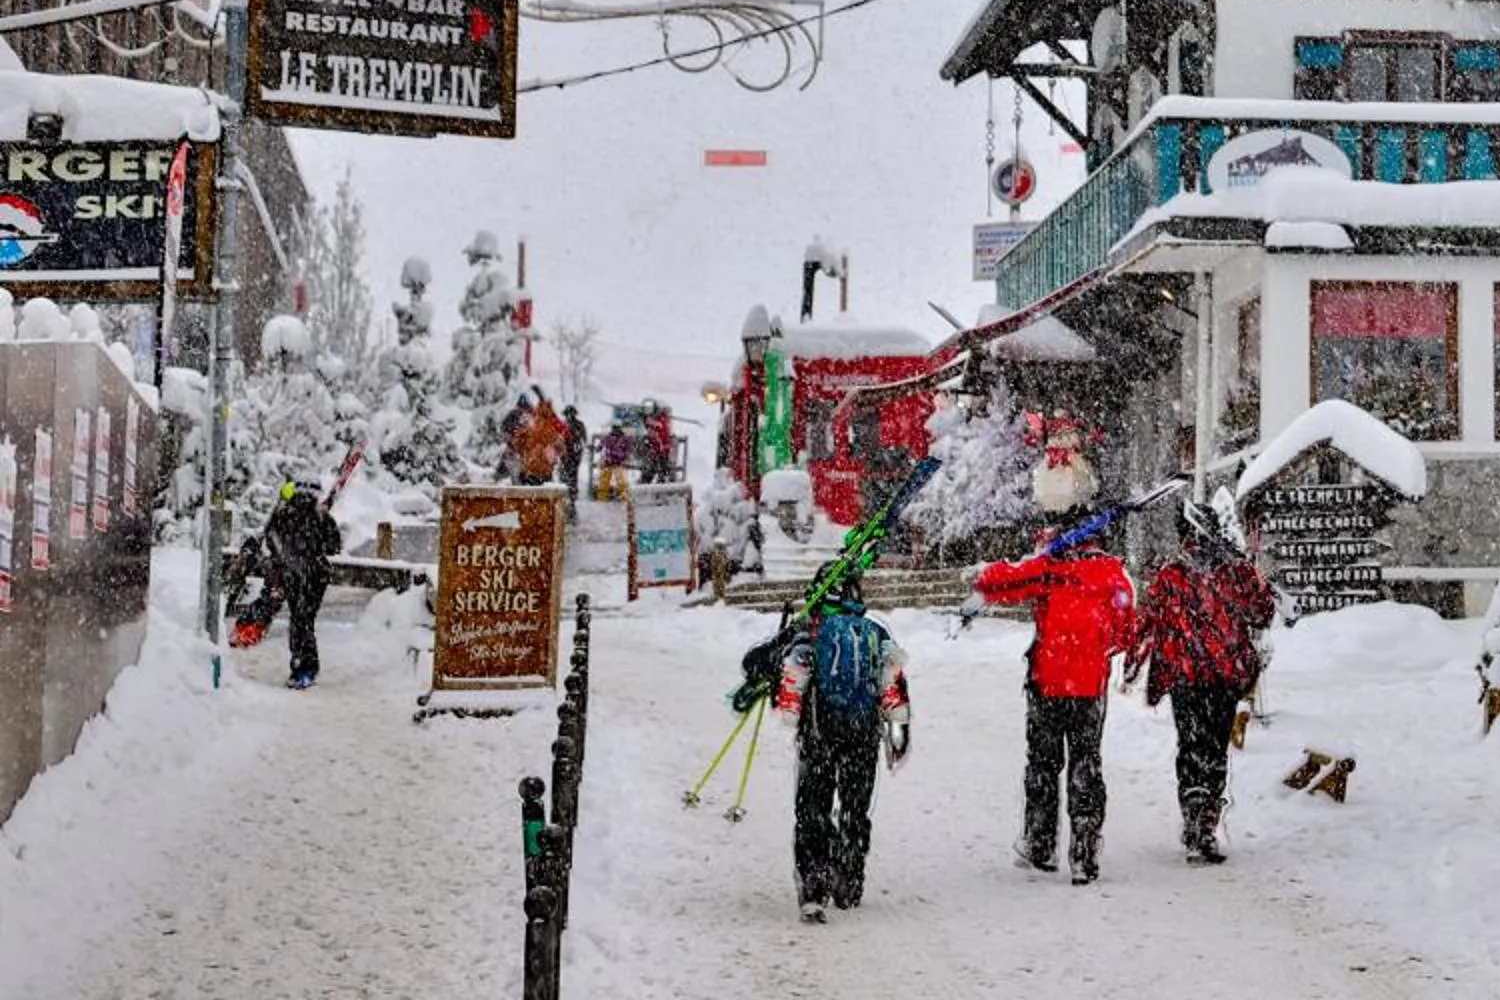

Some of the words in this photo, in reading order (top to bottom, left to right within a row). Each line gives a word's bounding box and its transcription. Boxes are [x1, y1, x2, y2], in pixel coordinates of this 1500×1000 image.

[285, 10, 465, 46] RESTAURANT
[279, 46, 318, 94] LE
[326, 53, 486, 108] TREMPLIN
[73, 193, 166, 220] SKI
[457, 545, 542, 567] BERGER
[479, 569, 514, 590] SKI
[455, 591, 541, 613] SERVICE
